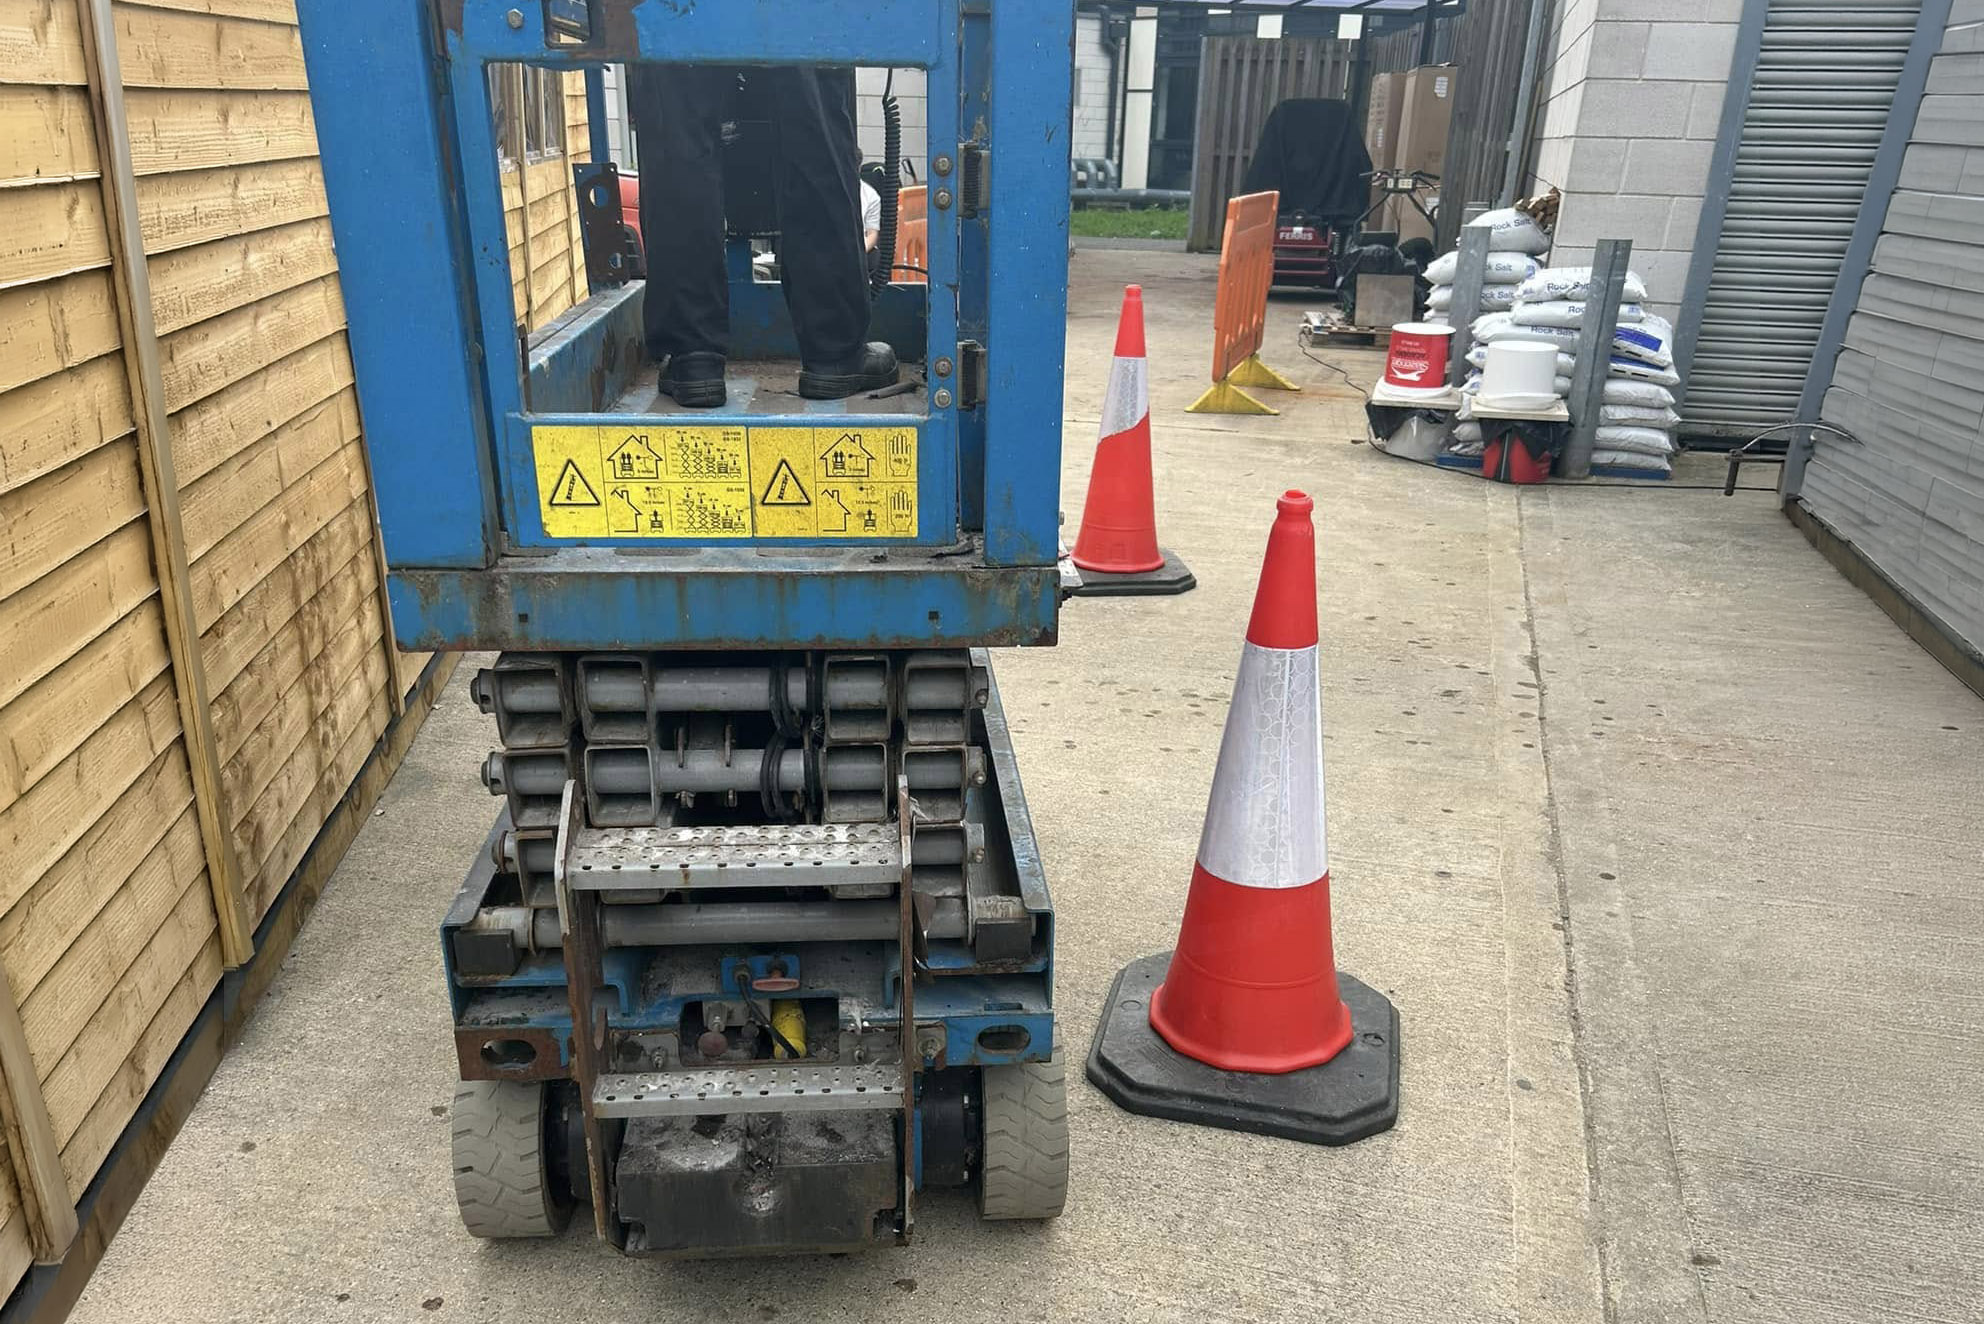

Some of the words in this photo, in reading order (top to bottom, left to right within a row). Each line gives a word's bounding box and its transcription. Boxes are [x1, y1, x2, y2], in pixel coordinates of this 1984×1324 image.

[1513, 218, 1532, 228] Salt
[1494, 262, 1513, 271] Salt
[1567, 305, 1586, 314] Roc
